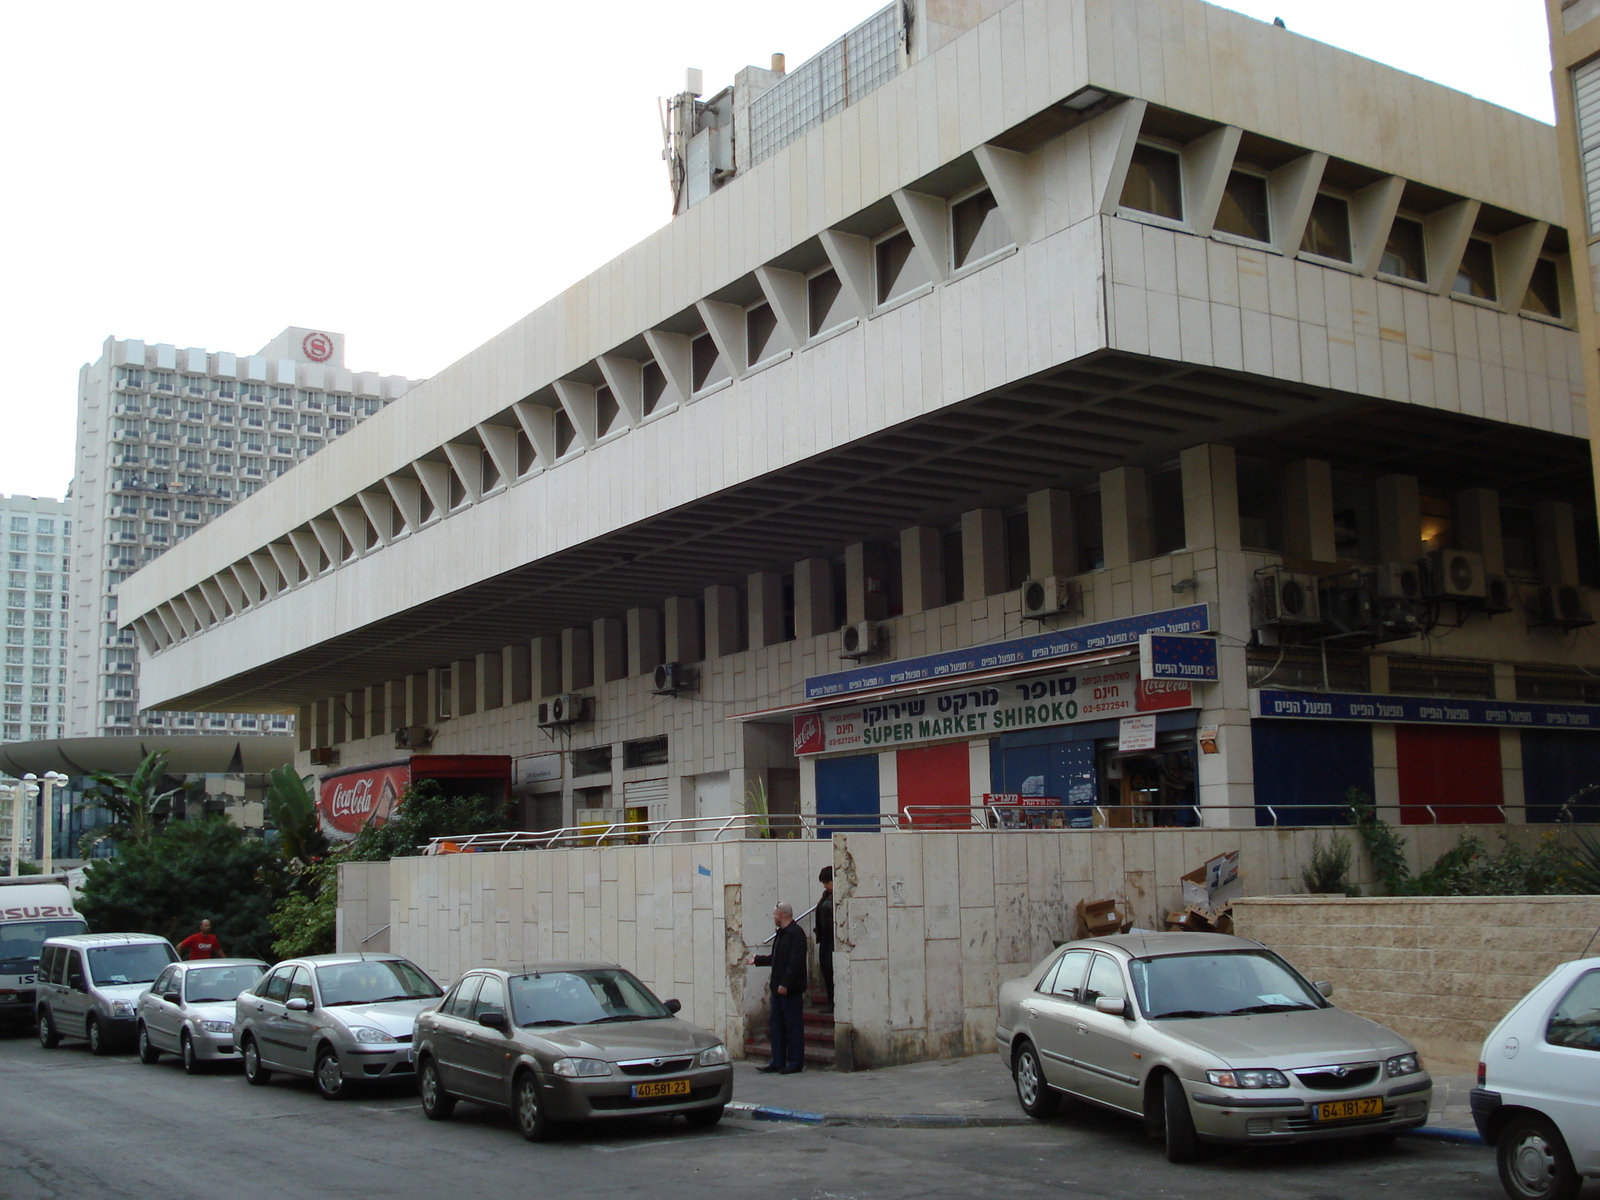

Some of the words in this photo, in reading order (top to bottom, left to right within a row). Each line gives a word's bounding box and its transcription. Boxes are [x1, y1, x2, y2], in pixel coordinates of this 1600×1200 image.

[311, 338, 326, 356] S
[1178, 662, 1204, 675] מפעל
[1016, 677, 1076, 700] סופר
[1094, 685, 1118, 700] חינם
[862, 700, 925, 726] שירוקו
[938, 689, 998, 715] מרקט
[864, 722, 913, 744] SUPER
[919, 712, 987, 738] MARKET
[993, 700, 1078, 728] SHIROKO
[332, 778, 374, 817] Coca-Cola
[0, 906, 74, 920] ISUZU
